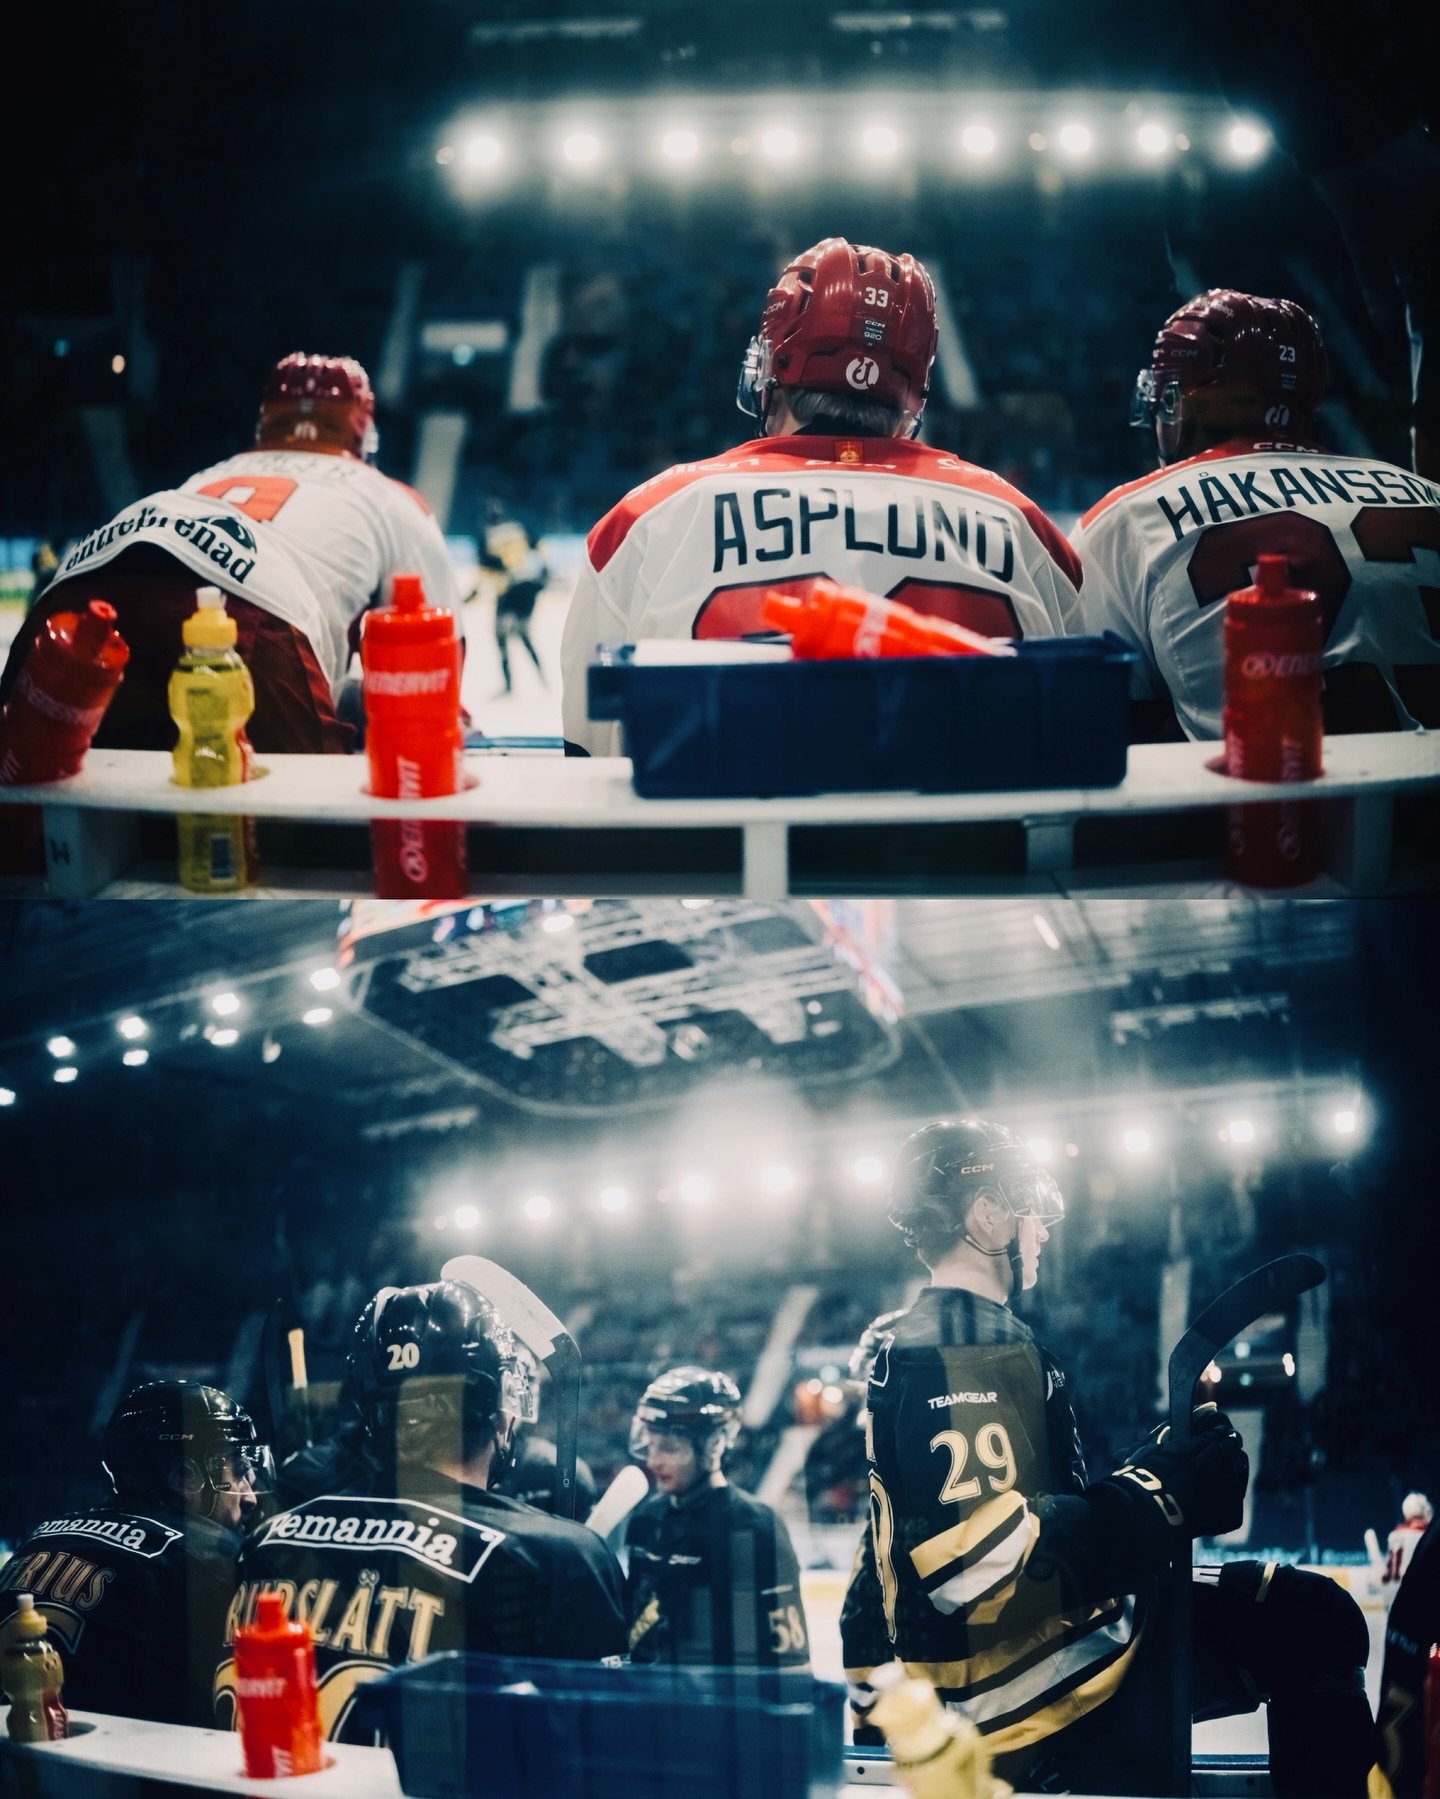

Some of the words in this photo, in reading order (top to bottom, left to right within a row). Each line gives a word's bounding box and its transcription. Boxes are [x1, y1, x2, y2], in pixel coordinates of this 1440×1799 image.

[864, 286, 889, 308] 33
[765, 300, 786, 315] CCM
[864, 319, 886, 328] CCM
[863, 331, 882, 341] 920
[1170, 348, 1199, 358] CCM
[1278, 344, 1296, 363] 23
[1252, 442, 1319, 454] CCM
[712, 487, 1014, 584] ASPLUND
[960, 1162, 995, 1175] CCM
[386, 1341, 421, 1372] 20
[927, 1391, 998, 1410] TEAMGEAR
[158, 1433, 195, 1441] CCM
[929, 1422, 1018, 1506] 29
[32, 1516, 148, 1550] emannia
[8, 1551, 118, 1611] RIUS
